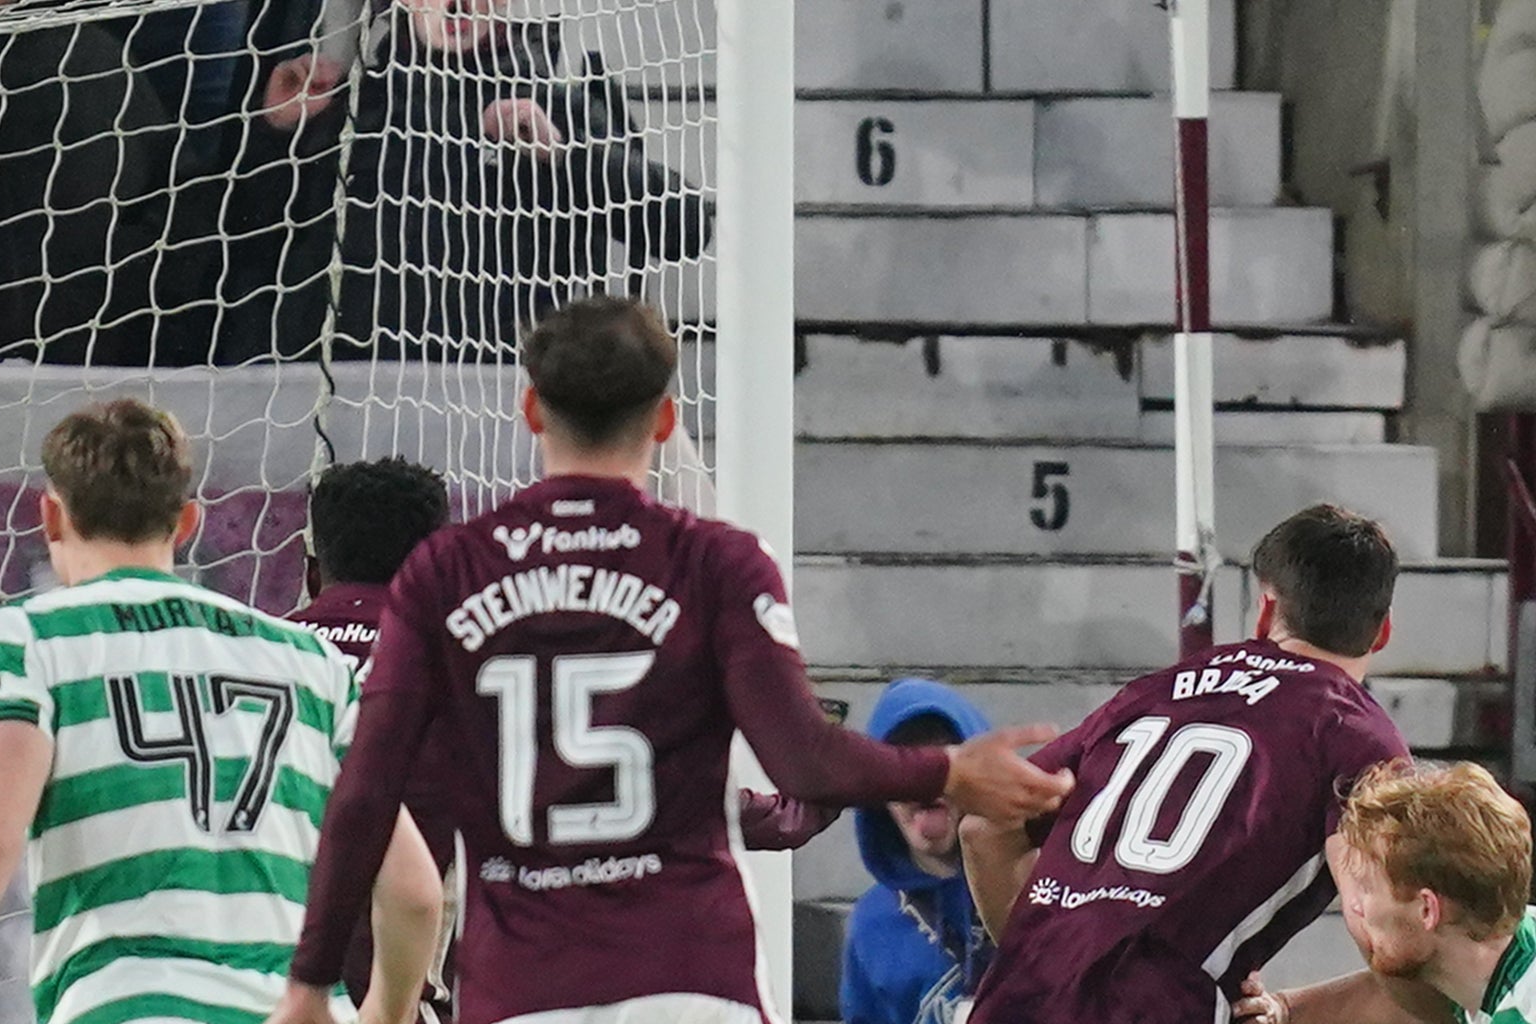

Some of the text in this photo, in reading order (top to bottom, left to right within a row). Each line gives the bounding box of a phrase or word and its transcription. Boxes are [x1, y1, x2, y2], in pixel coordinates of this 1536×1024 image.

[854, 117, 896, 186] 6
[1029, 461, 1071, 531] 5
[306, 622, 382, 643] anHu
[445, 564, 682, 652] STEINWENDER
[104, 672, 296, 836] 47
[475, 650, 657, 847] 15
[1071, 715, 1252, 874] 10
